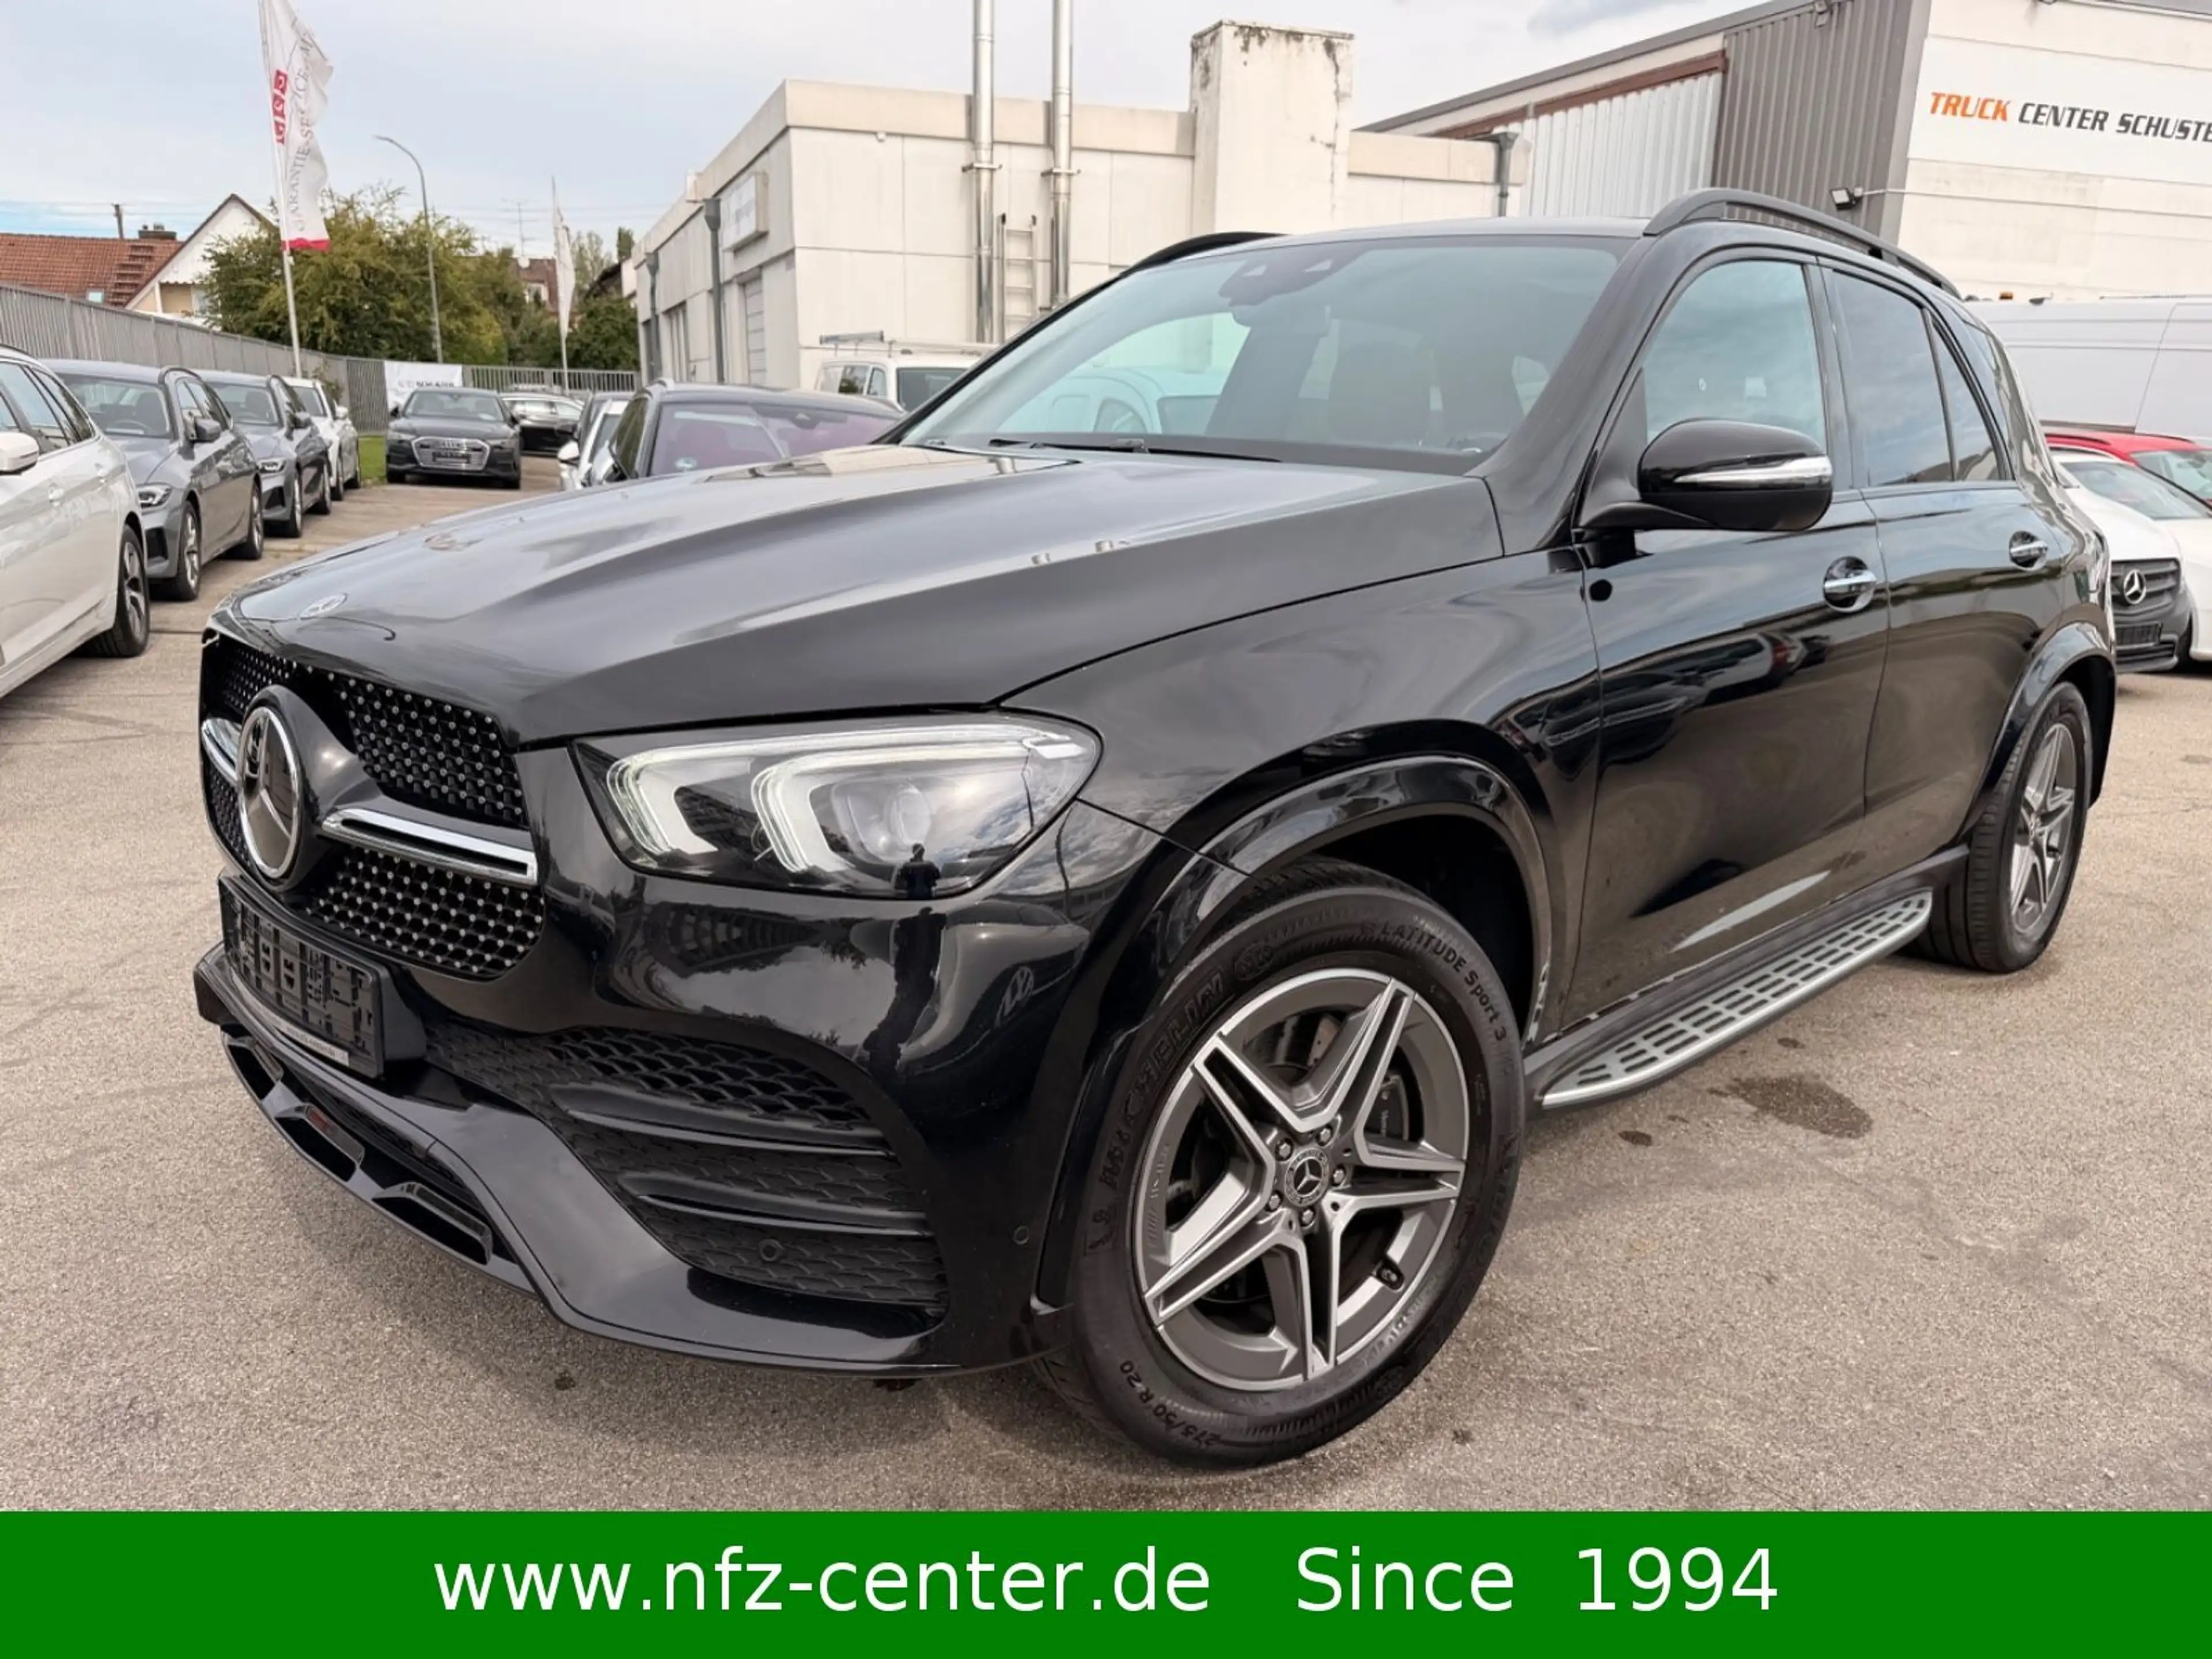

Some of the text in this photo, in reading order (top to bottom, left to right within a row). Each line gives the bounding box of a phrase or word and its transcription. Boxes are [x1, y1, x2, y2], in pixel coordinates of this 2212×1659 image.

[1930, 92, 2011, 122] TRUCK
[2018, 102, 2109, 132] CENTER
[1381, 921, 1507, 1041] LATITUDE Sport 3
[1120, 1360, 1142, 1388] 20
